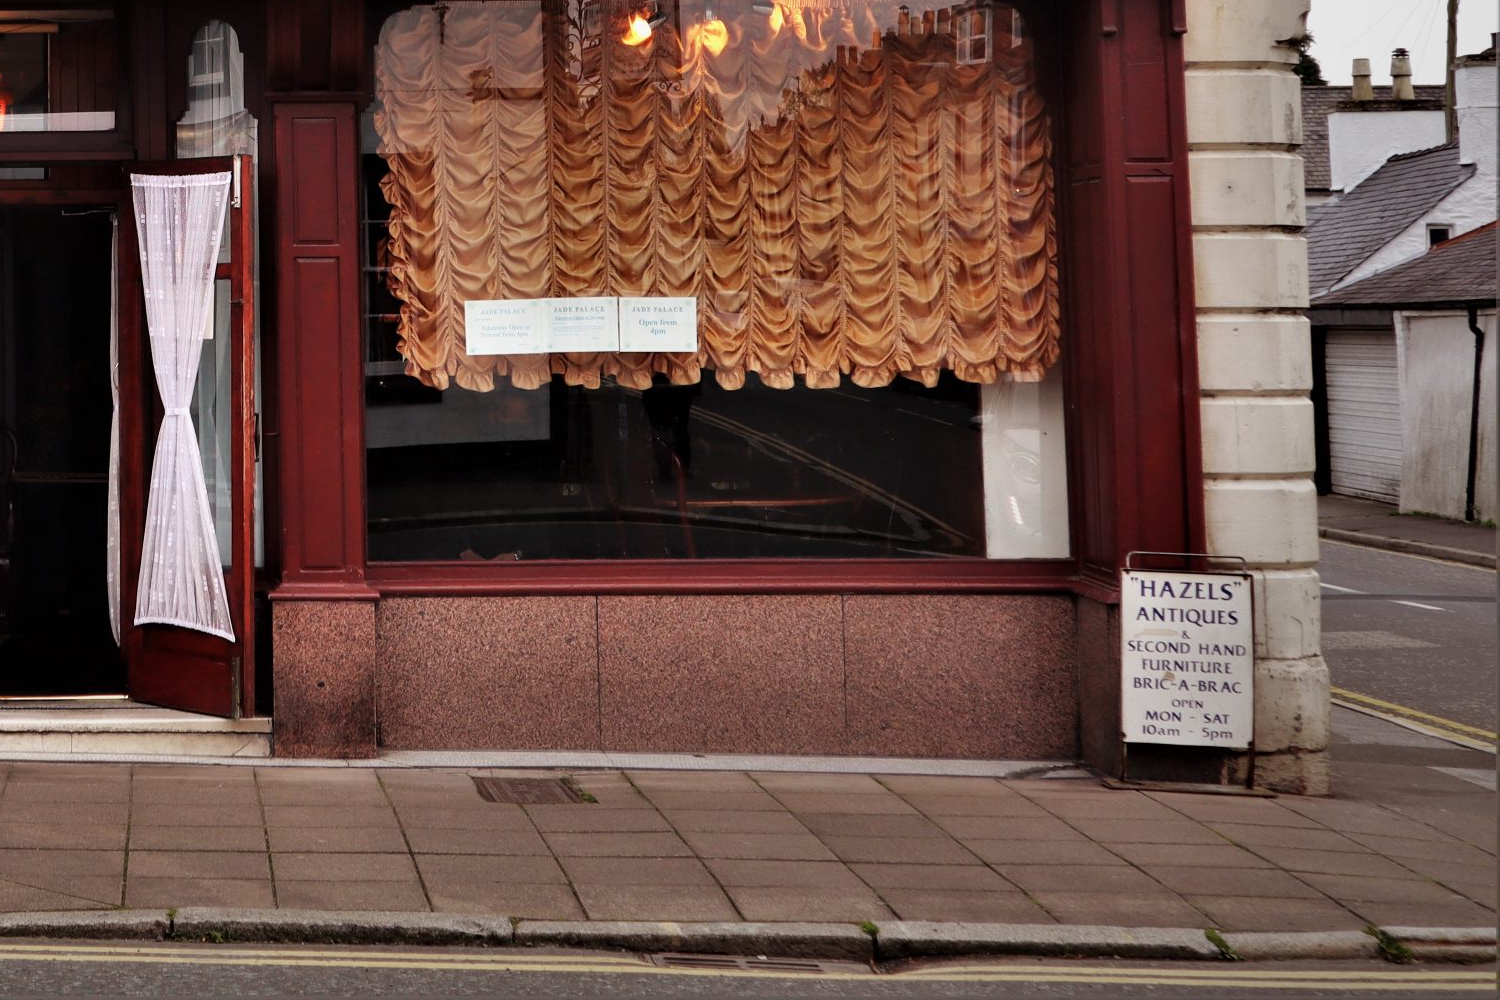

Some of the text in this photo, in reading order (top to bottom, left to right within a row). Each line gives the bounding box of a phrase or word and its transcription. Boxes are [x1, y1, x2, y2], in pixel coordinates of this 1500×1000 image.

[575, 305, 605, 313] PALACE
[638, 319, 658, 328] Open
[650, 327, 666, 336] 4pm
[1136, 606, 1239, 627] ANTIQUES
[1181, 630, 1191, 640] &
[1128, 640, 1246, 657] SECOND HAND
[1142, 659, 1233, 675] FURNITURE
[1133, 677, 1242, 694] BRIC-A-BRAC
[1172, 698, 1204, 709] OPEN
[1145, 711, 1182, 723] MON
[1204, 713, 1231, 725] SAT
[1142, 724, 1181, 737] 10am
[1202, 728, 1234, 741] 5pm
